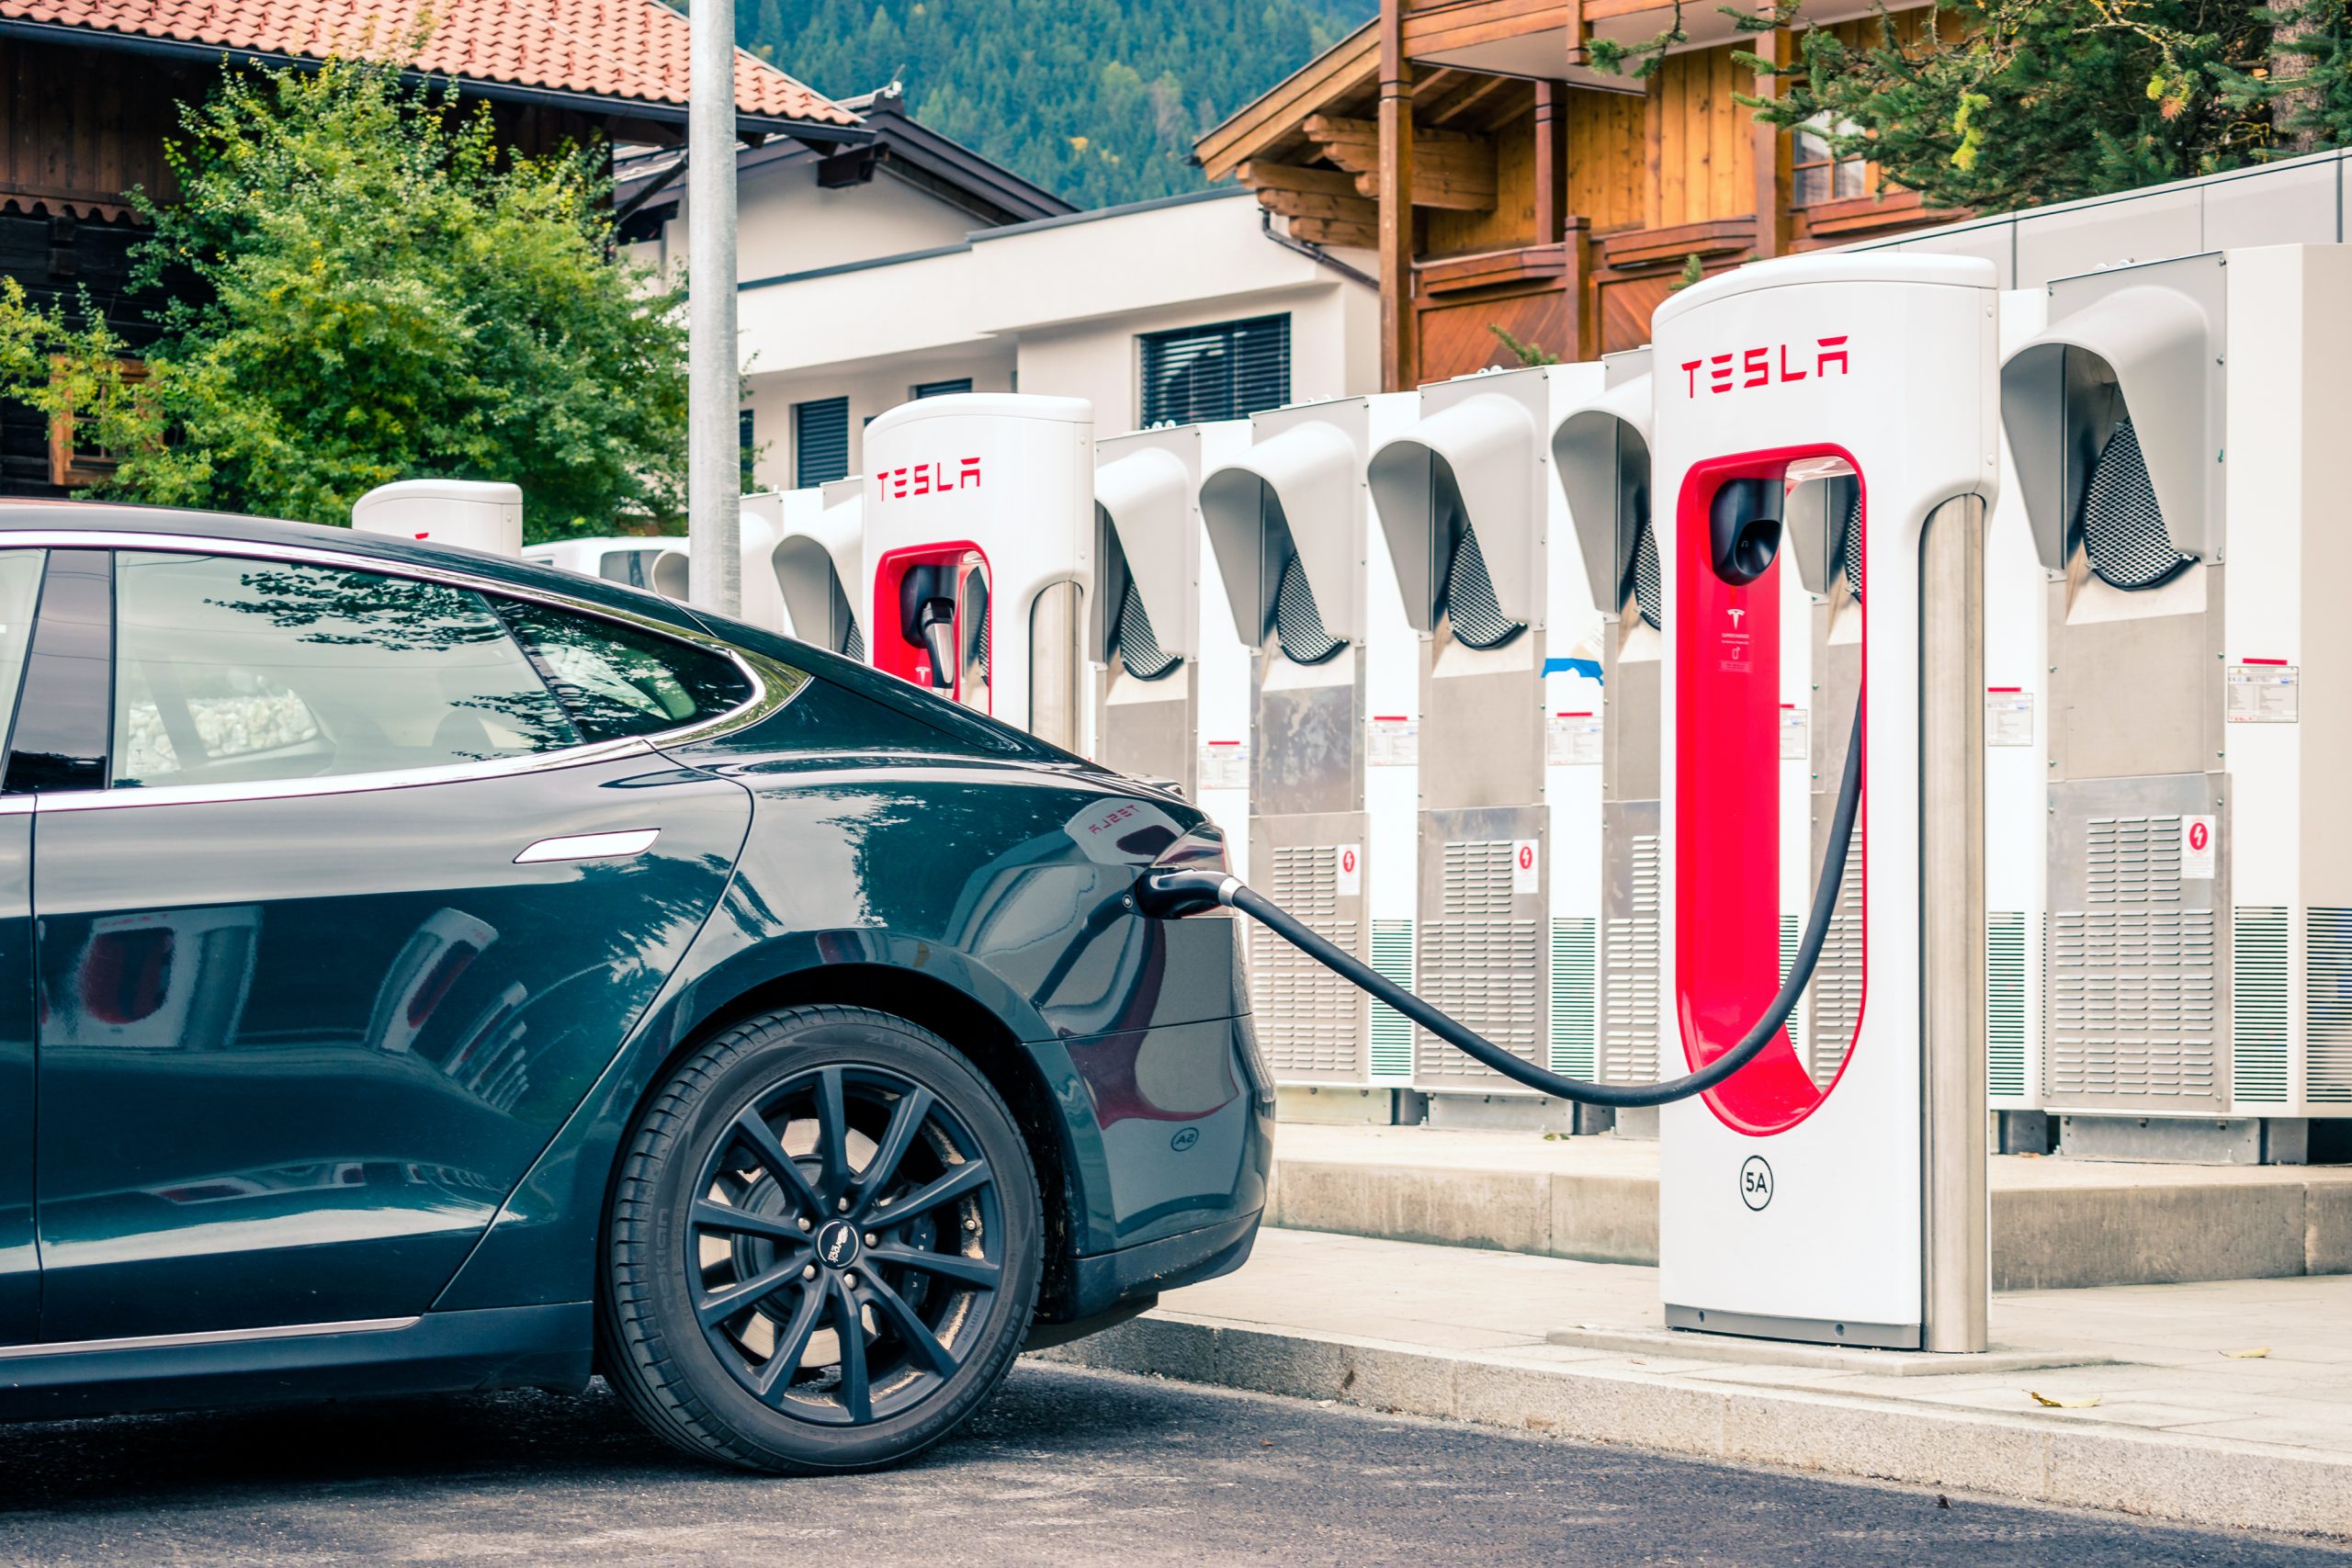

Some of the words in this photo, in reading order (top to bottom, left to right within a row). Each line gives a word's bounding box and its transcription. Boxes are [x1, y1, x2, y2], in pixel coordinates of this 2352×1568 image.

[1681, 335, 1849, 399] TESLA
[876, 457, 980, 502] TESLA
[1746, 1171, 1768, 1193] 5A
